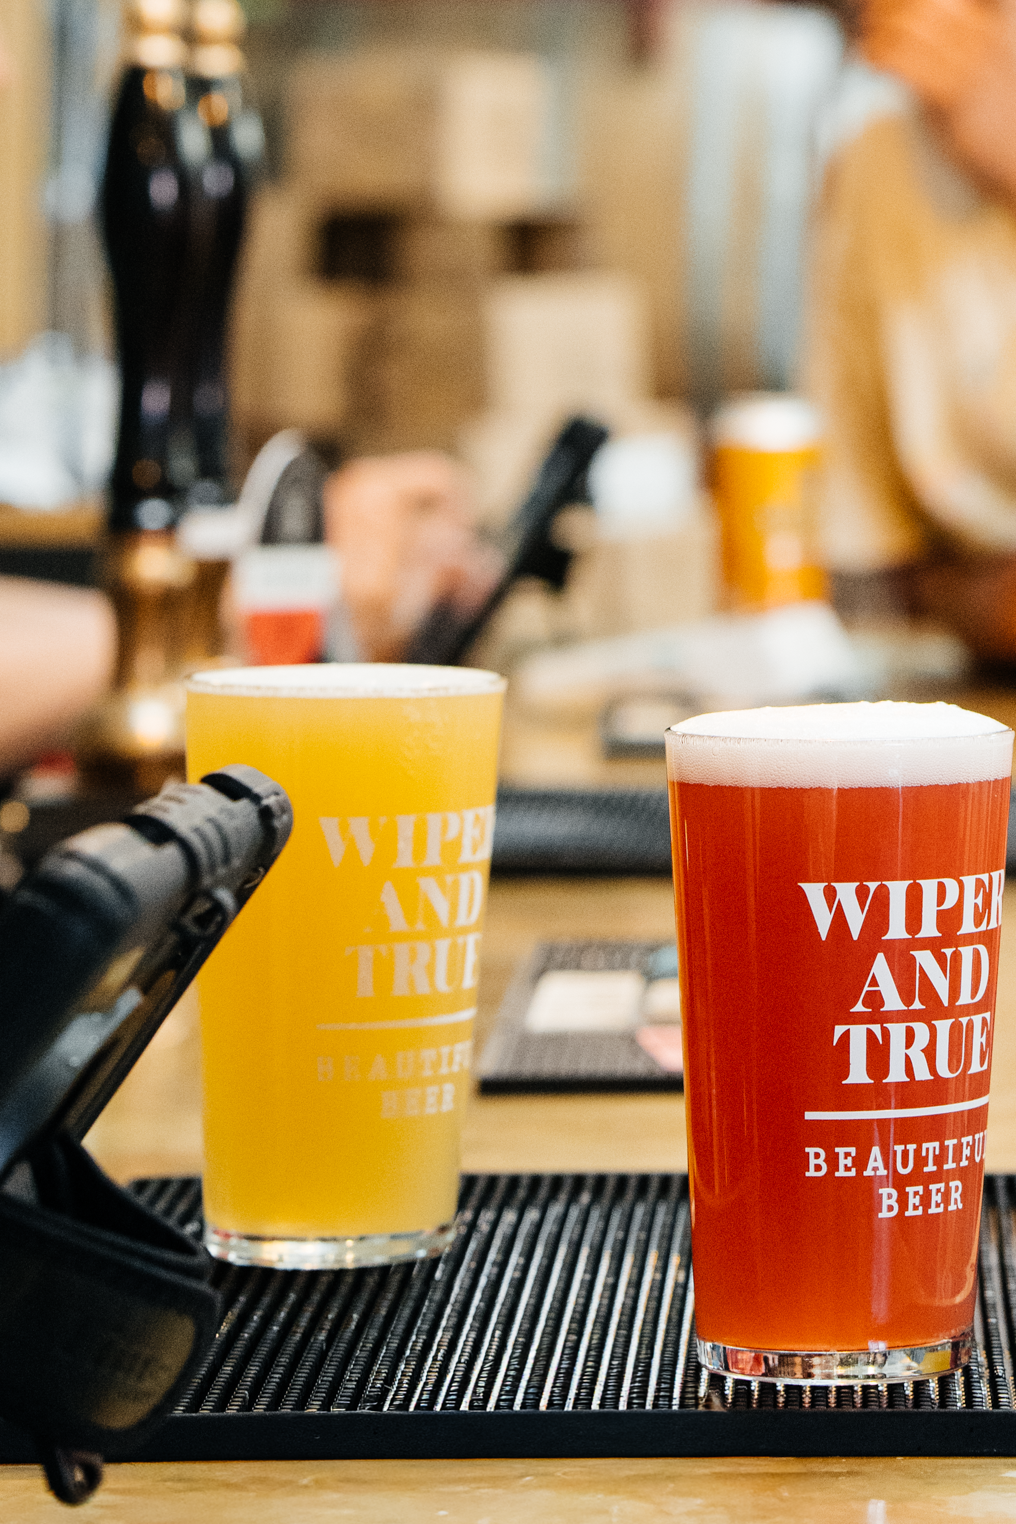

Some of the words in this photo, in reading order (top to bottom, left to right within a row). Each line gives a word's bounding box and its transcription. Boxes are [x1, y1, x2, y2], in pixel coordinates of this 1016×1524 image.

[363, 870, 483, 932] AND
[797, 869, 1005, 942] WIPER
[850, 944, 989, 1012] AND
[833, 1012, 991, 1084] TRUE
[878, 1180, 963, 1219] BEER
